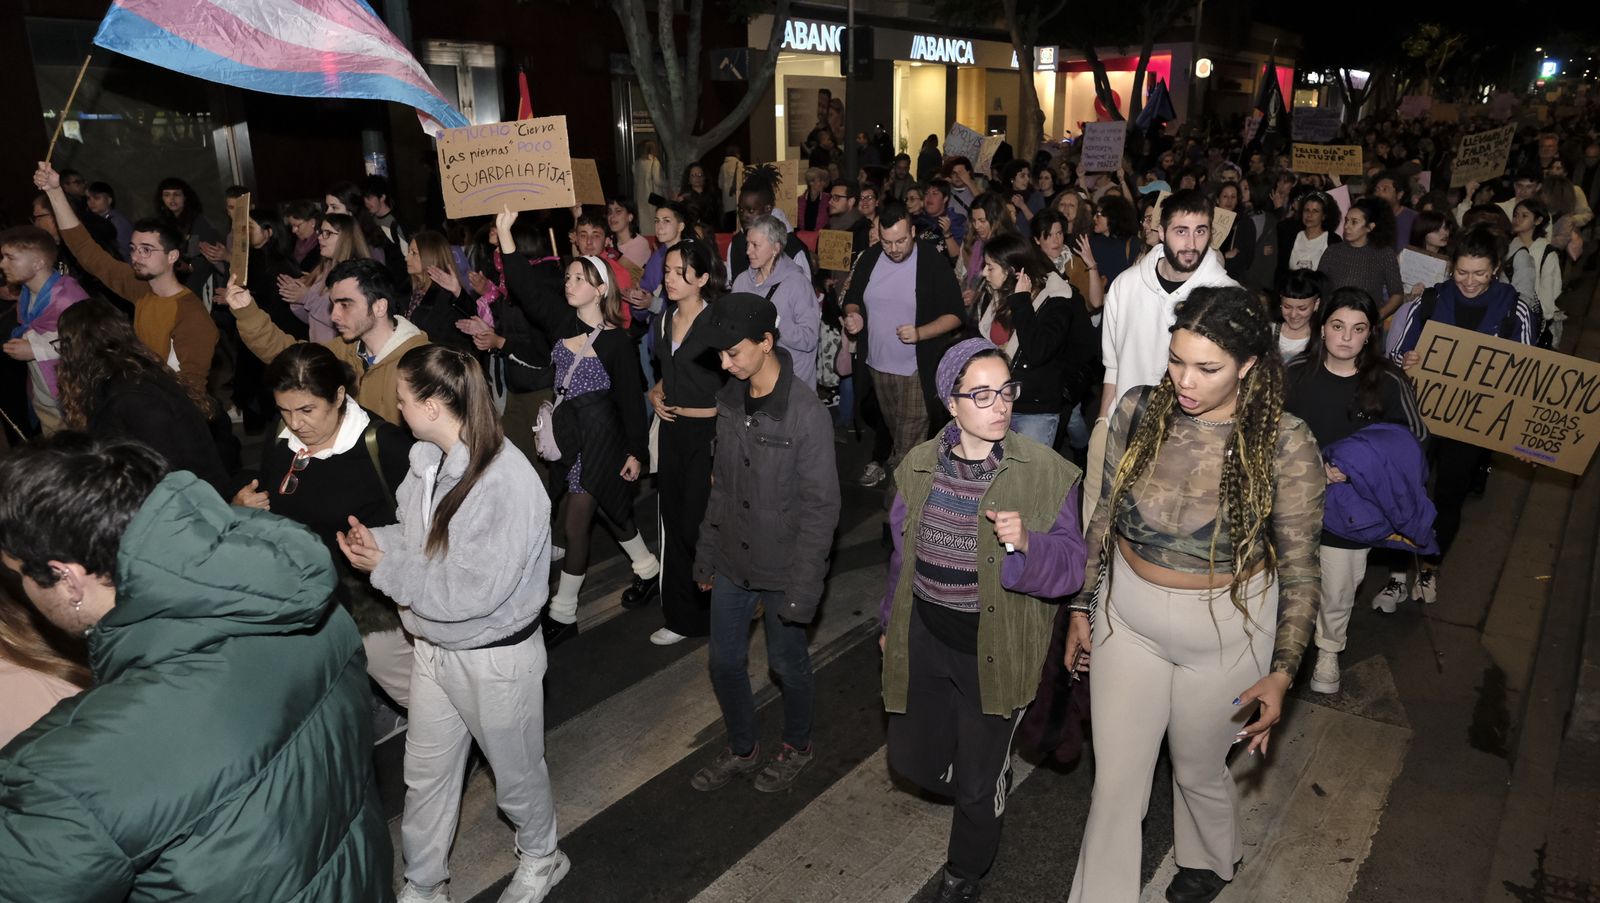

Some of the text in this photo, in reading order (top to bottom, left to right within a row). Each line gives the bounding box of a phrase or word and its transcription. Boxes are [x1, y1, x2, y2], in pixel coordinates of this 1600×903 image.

[781, 20, 846, 52] ABANC
[913, 35, 975, 65] ABANCA
[452, 125, 511, 143] MUCHO
[441, 149, 466, 165] las
[517, 141, 553, 153] POCO
[1463, 142, 1491, 158] FALDA
[518, 163, 534, 177] LA
[1421, 335, 1600, 414] EL FEMINISMO
[1411, 376, 1515, 440] NCLUYE A
[1521, 433, 1562, 453] TODOS
[1525, 419, 1584, 444] TODES Y
